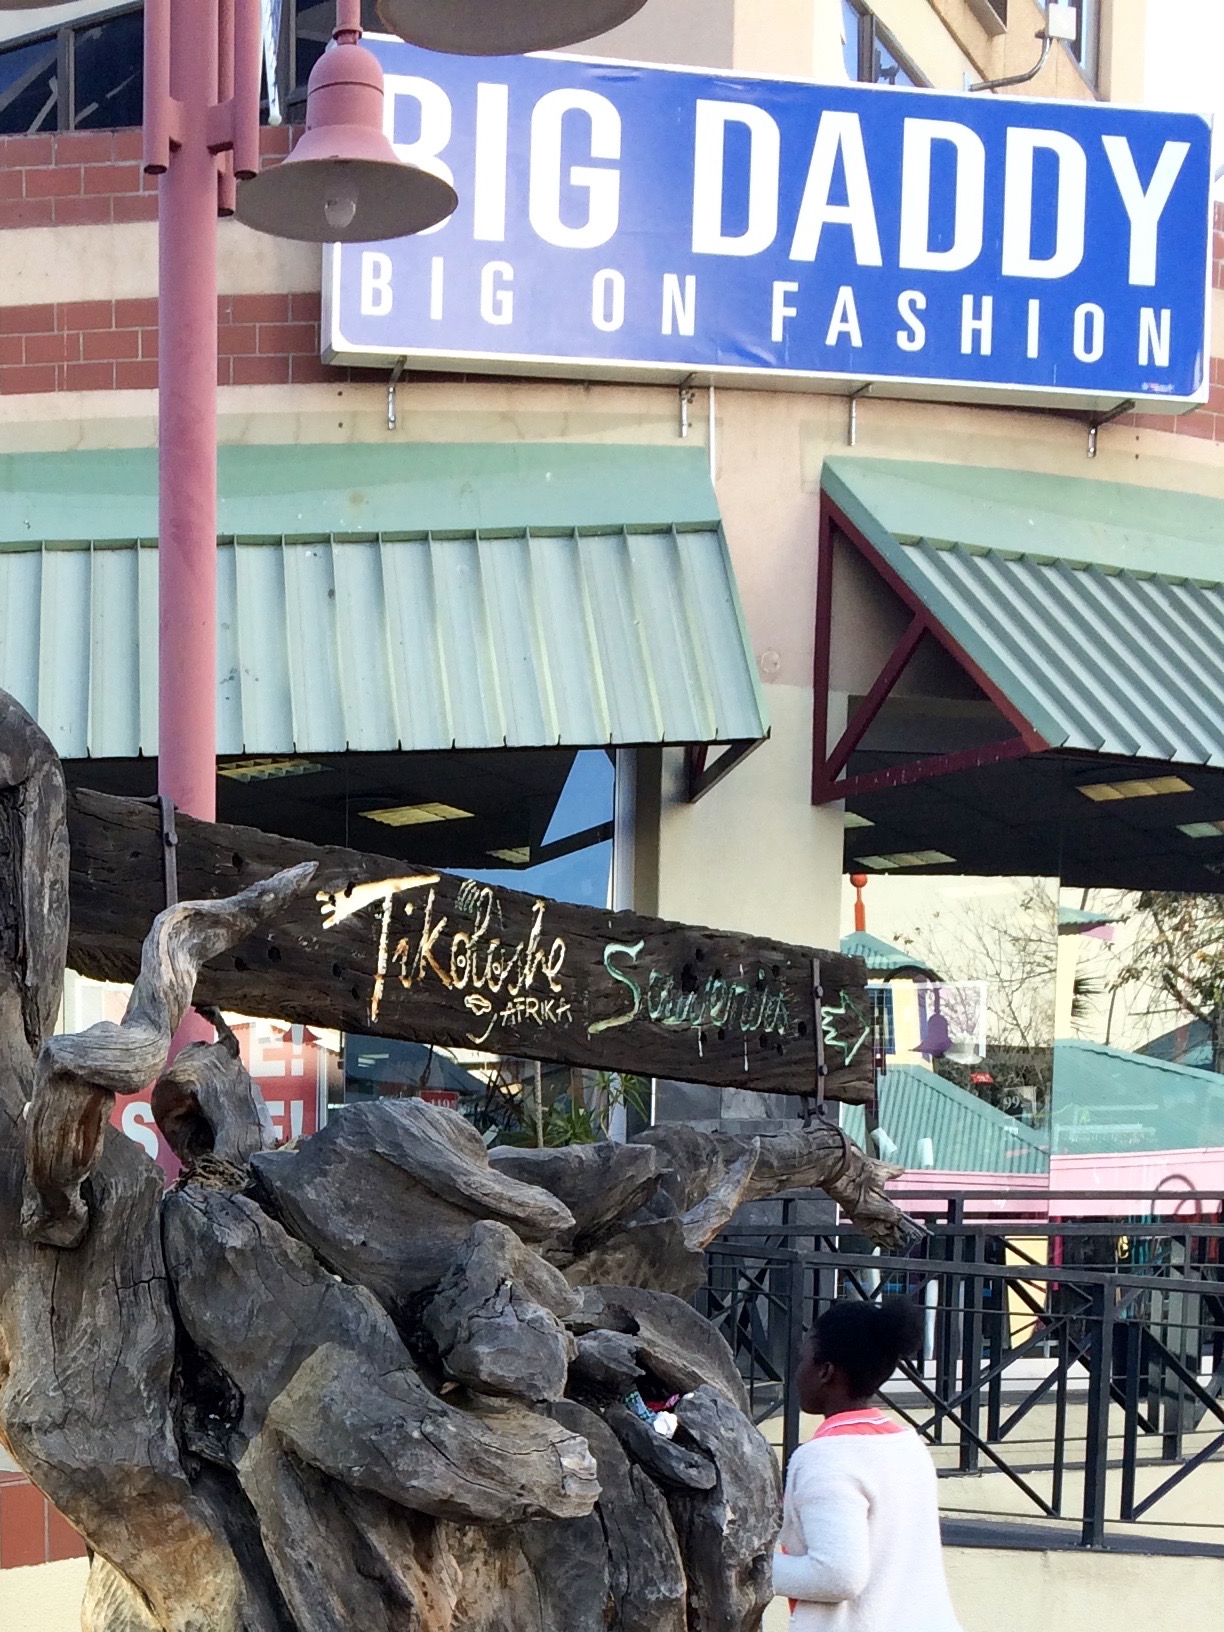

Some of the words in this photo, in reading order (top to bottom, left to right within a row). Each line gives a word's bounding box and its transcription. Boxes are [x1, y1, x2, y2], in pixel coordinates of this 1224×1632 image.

[692, 98, 1191, 287] DADDY
[361, 251, 515, 325] BIG
[592, 268, 696, 337] ON
[771, 280, 1171, 367] FASHION
[499, 997, 573, 1027] AFRIKA
